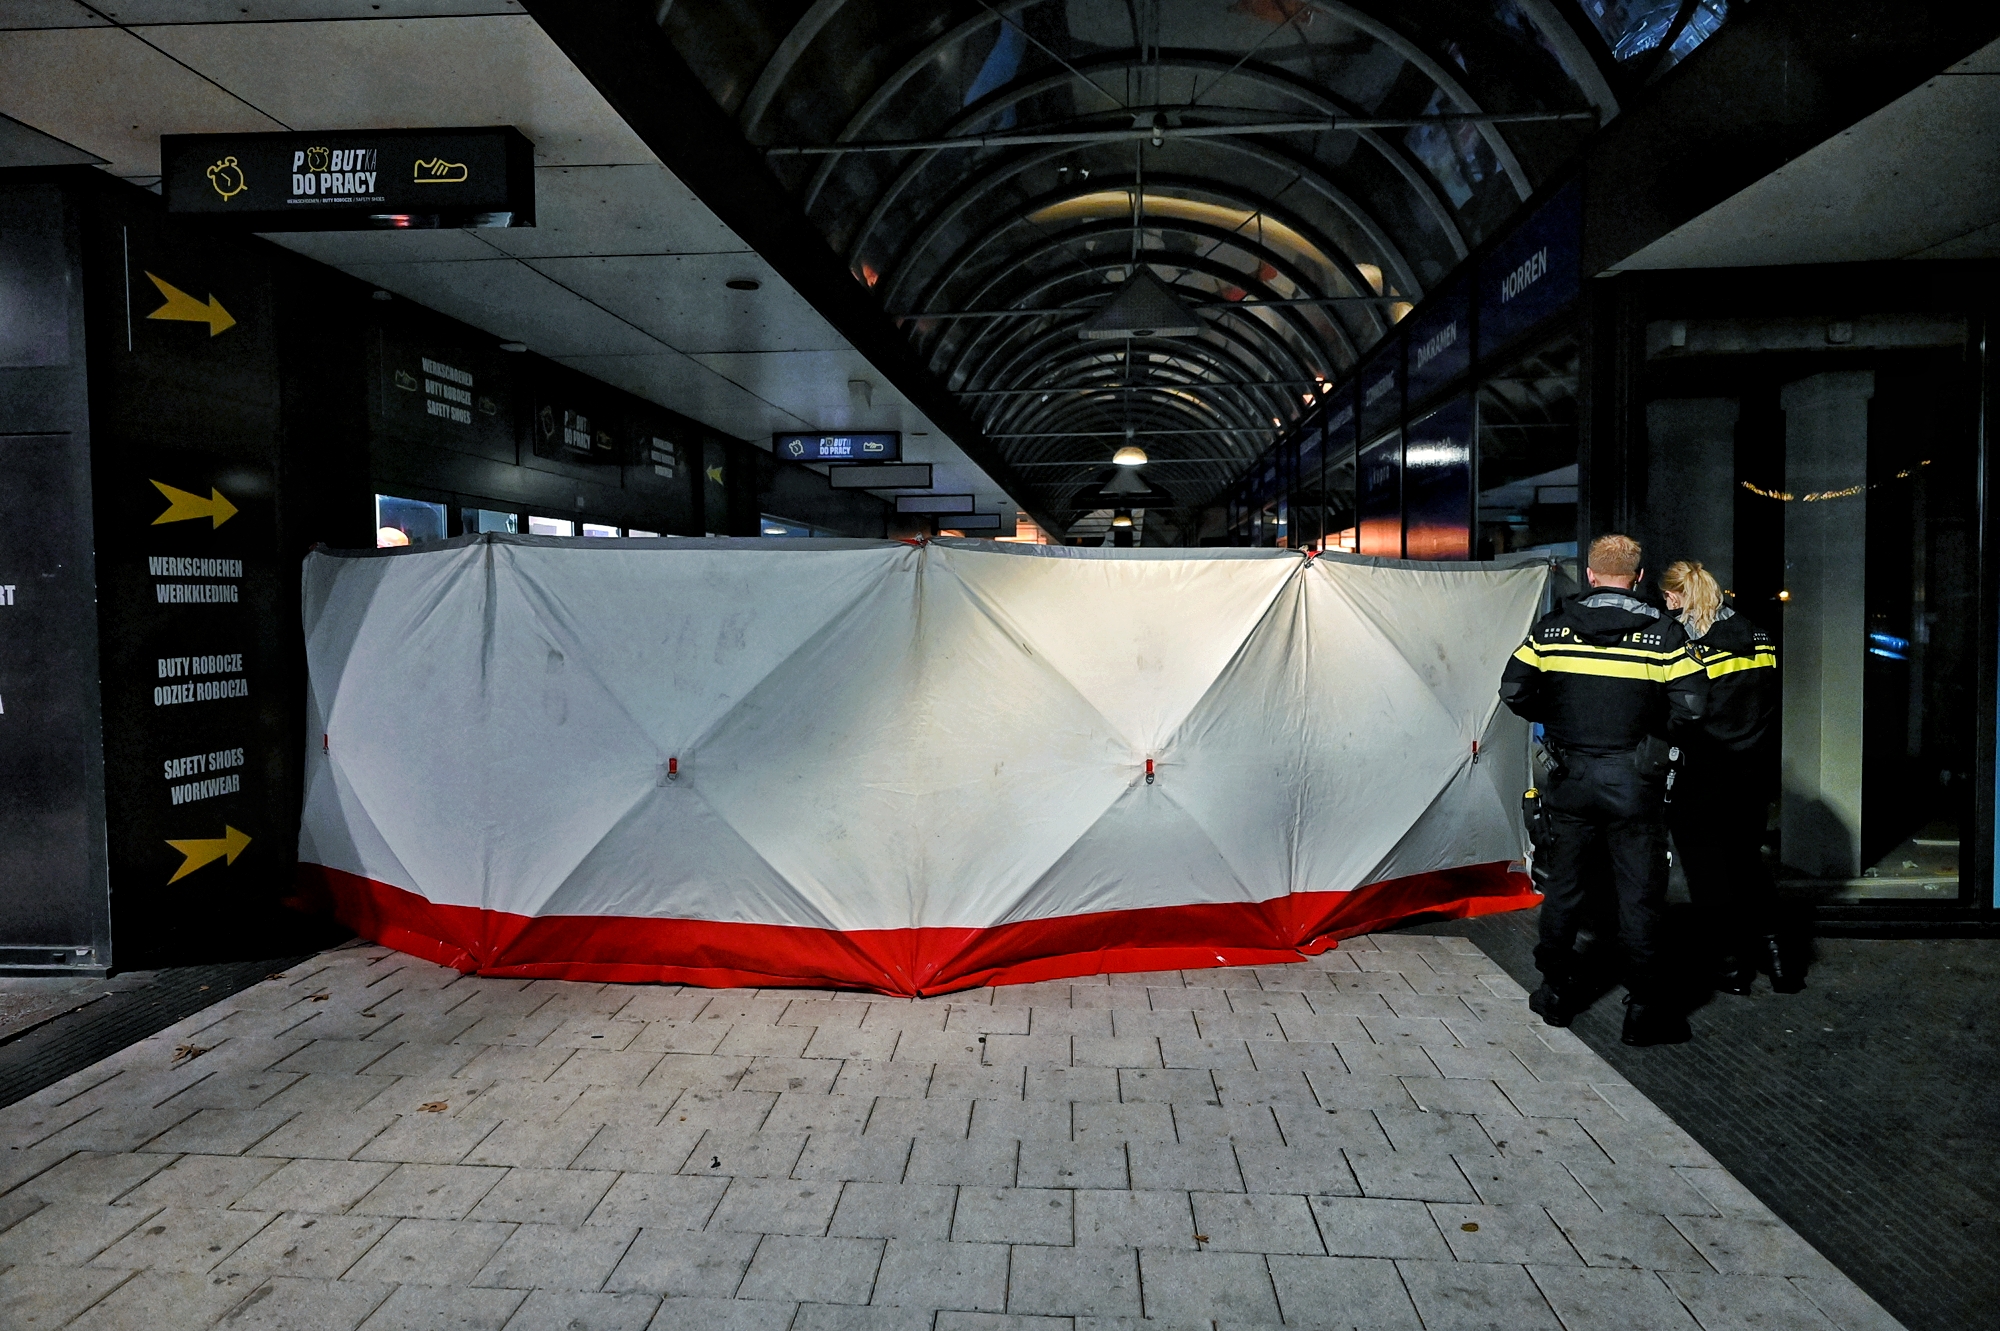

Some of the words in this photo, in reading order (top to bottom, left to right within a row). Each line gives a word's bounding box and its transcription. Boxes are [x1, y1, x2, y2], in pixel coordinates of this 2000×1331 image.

[292, 173, 316, 195] DO
[320, 172, 377, 195] PRACY
[1502, 247, 1547, 303] HORREN
[426, 399, 450, 419] SAFETY
[820, 446, 829, 455] DO
[829, 446, 851, 455] PRACY
[148, 556, 243, 578] WERKSCHOENEN
[156, 583, 239, 603] WERKKLEDING
[157, 656, 191, 679] BUTY
[192, 653, 243, 676] ROBOCZE
[153, 680, 195, 707] ODZIEŻ
[196, 678, 249, 702] ROBOCZA
[163, 753, 208, 780] SAFETY
[208, 747, 245, 771] SHOES
[170, 773, 240, 806] WORKWEAR
